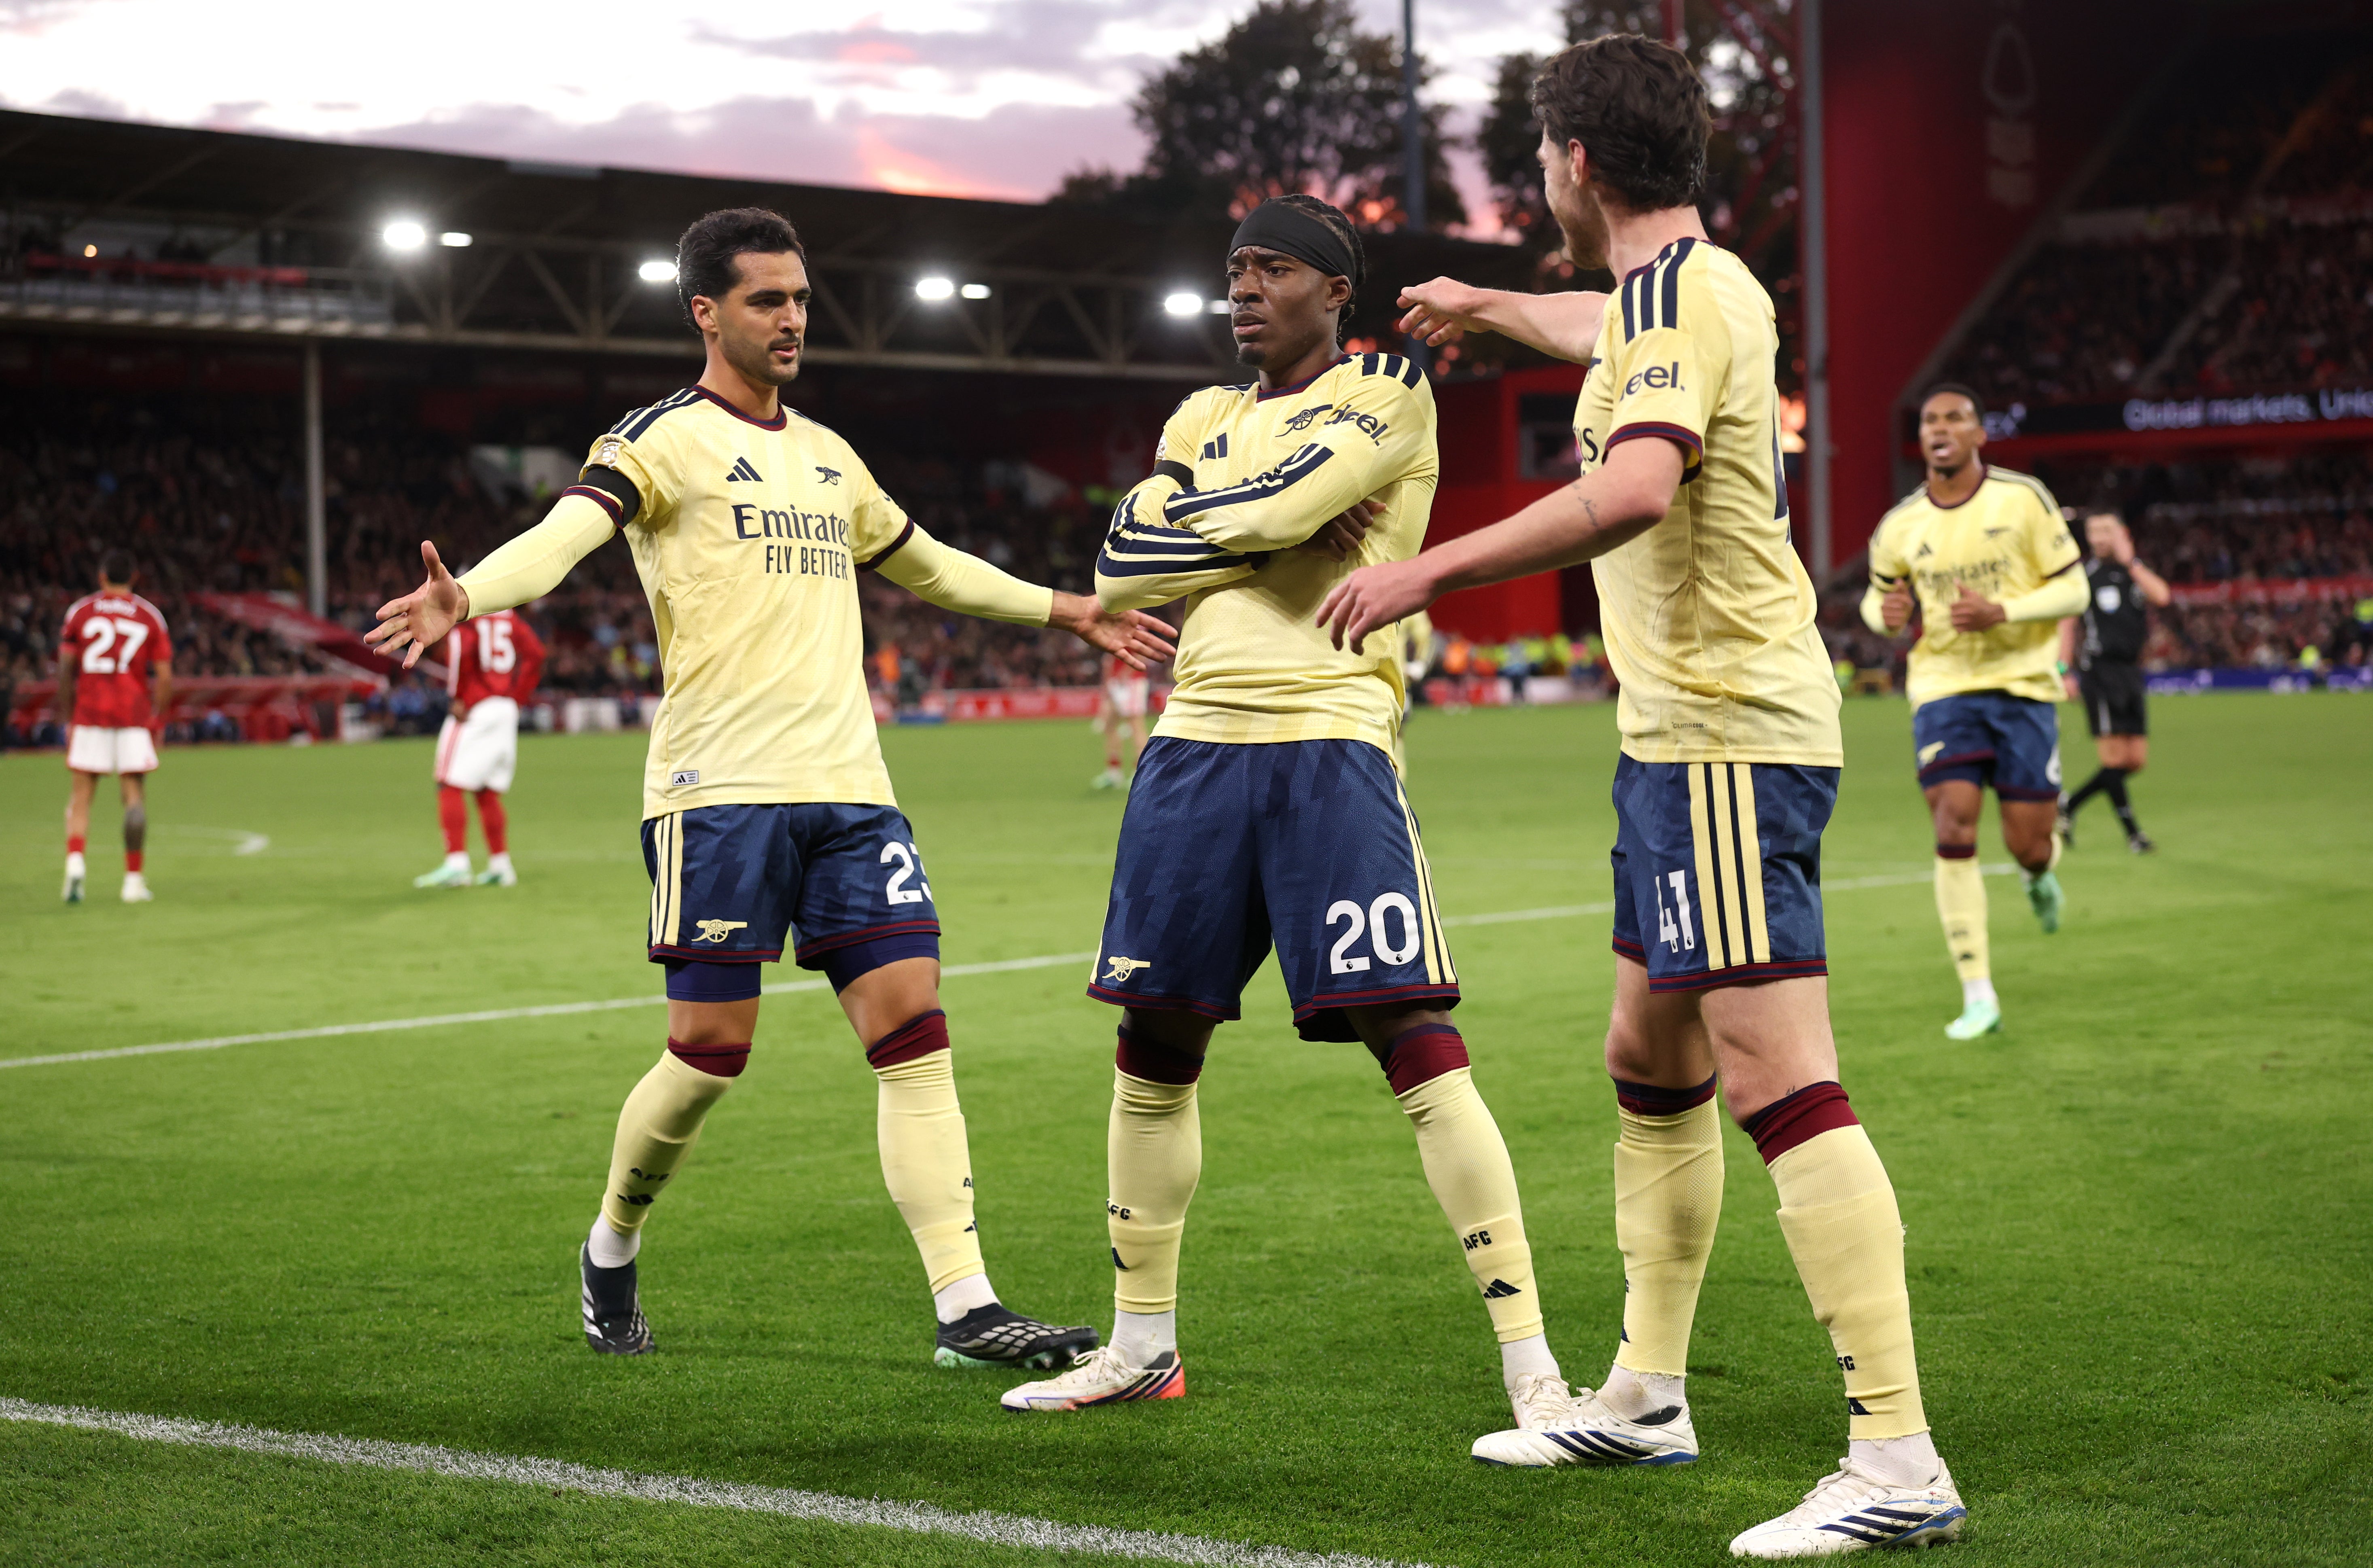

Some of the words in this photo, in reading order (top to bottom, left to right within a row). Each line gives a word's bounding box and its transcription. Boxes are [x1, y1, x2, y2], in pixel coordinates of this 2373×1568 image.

[1619, 361, 1685, 402] eel.
[1323, 404, 1389, 447] deel.
[766, 545, 792, 574] FLY
[801, 546, 848, 581] BETTER
[82, 616, 149, 674] 27
[475, 619, 517, 674] 15
[1326, 892, 1420, 975] 20
[1655, 869, 1695, 954] 41
[1463, 1230, 1492, 1251] AFC
